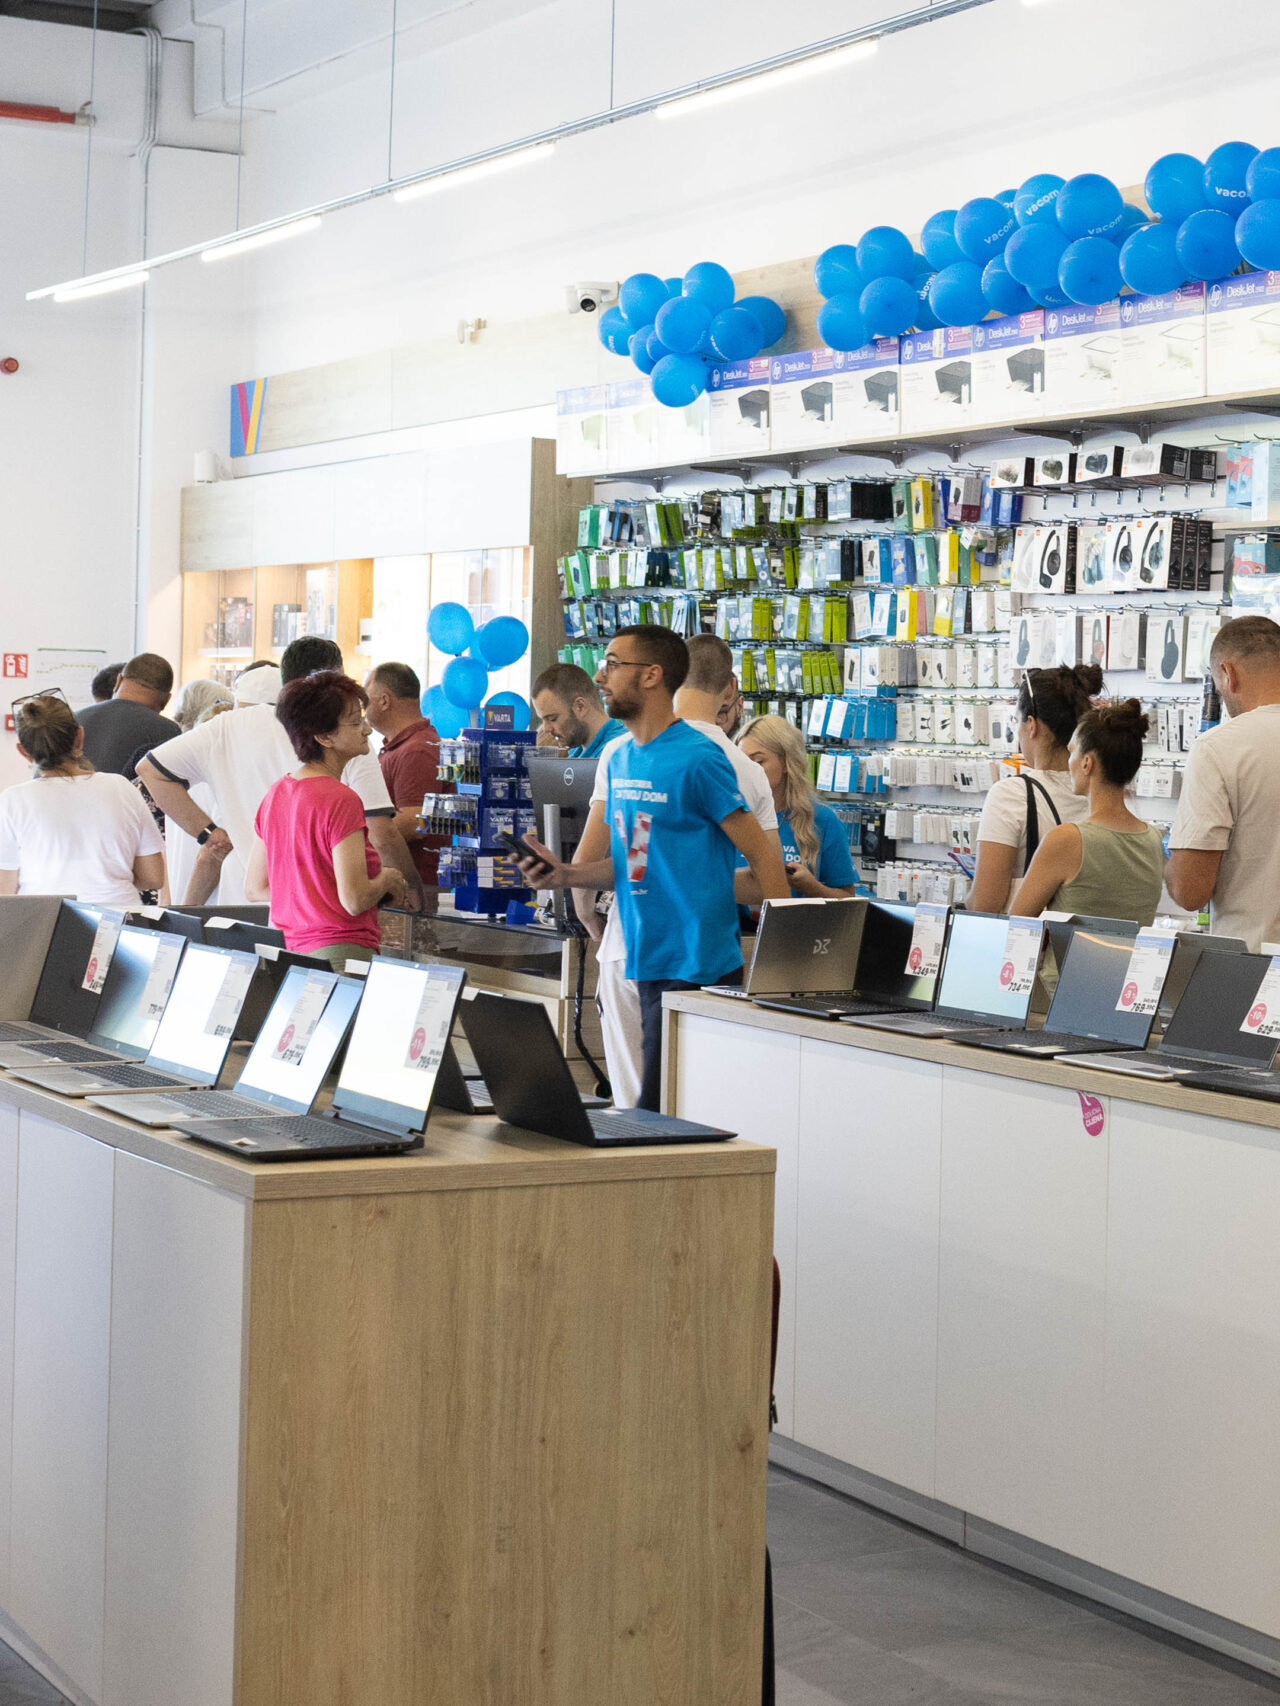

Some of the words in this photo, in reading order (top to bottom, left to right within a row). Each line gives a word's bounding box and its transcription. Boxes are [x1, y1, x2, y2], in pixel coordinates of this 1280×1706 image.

[1215, 186, 1247, 198] vaco
[1025, 189, 1059, 216] vacom
[984, 218, 1015, 243] vacom
[1088, 214, 1122, 235] vacom
[1226, 284, 1254, 297] DeskJet
[1061, 313, 1085, 325] DeskJet
[988, 323, 1010, 335] DeskJet
[784, 363, 804, 374] DeskJet
[723, 370, 742, 381] DeskJet
[494, 712, 511, 722] VARTA
[641, 791, 668, 803] DOM
